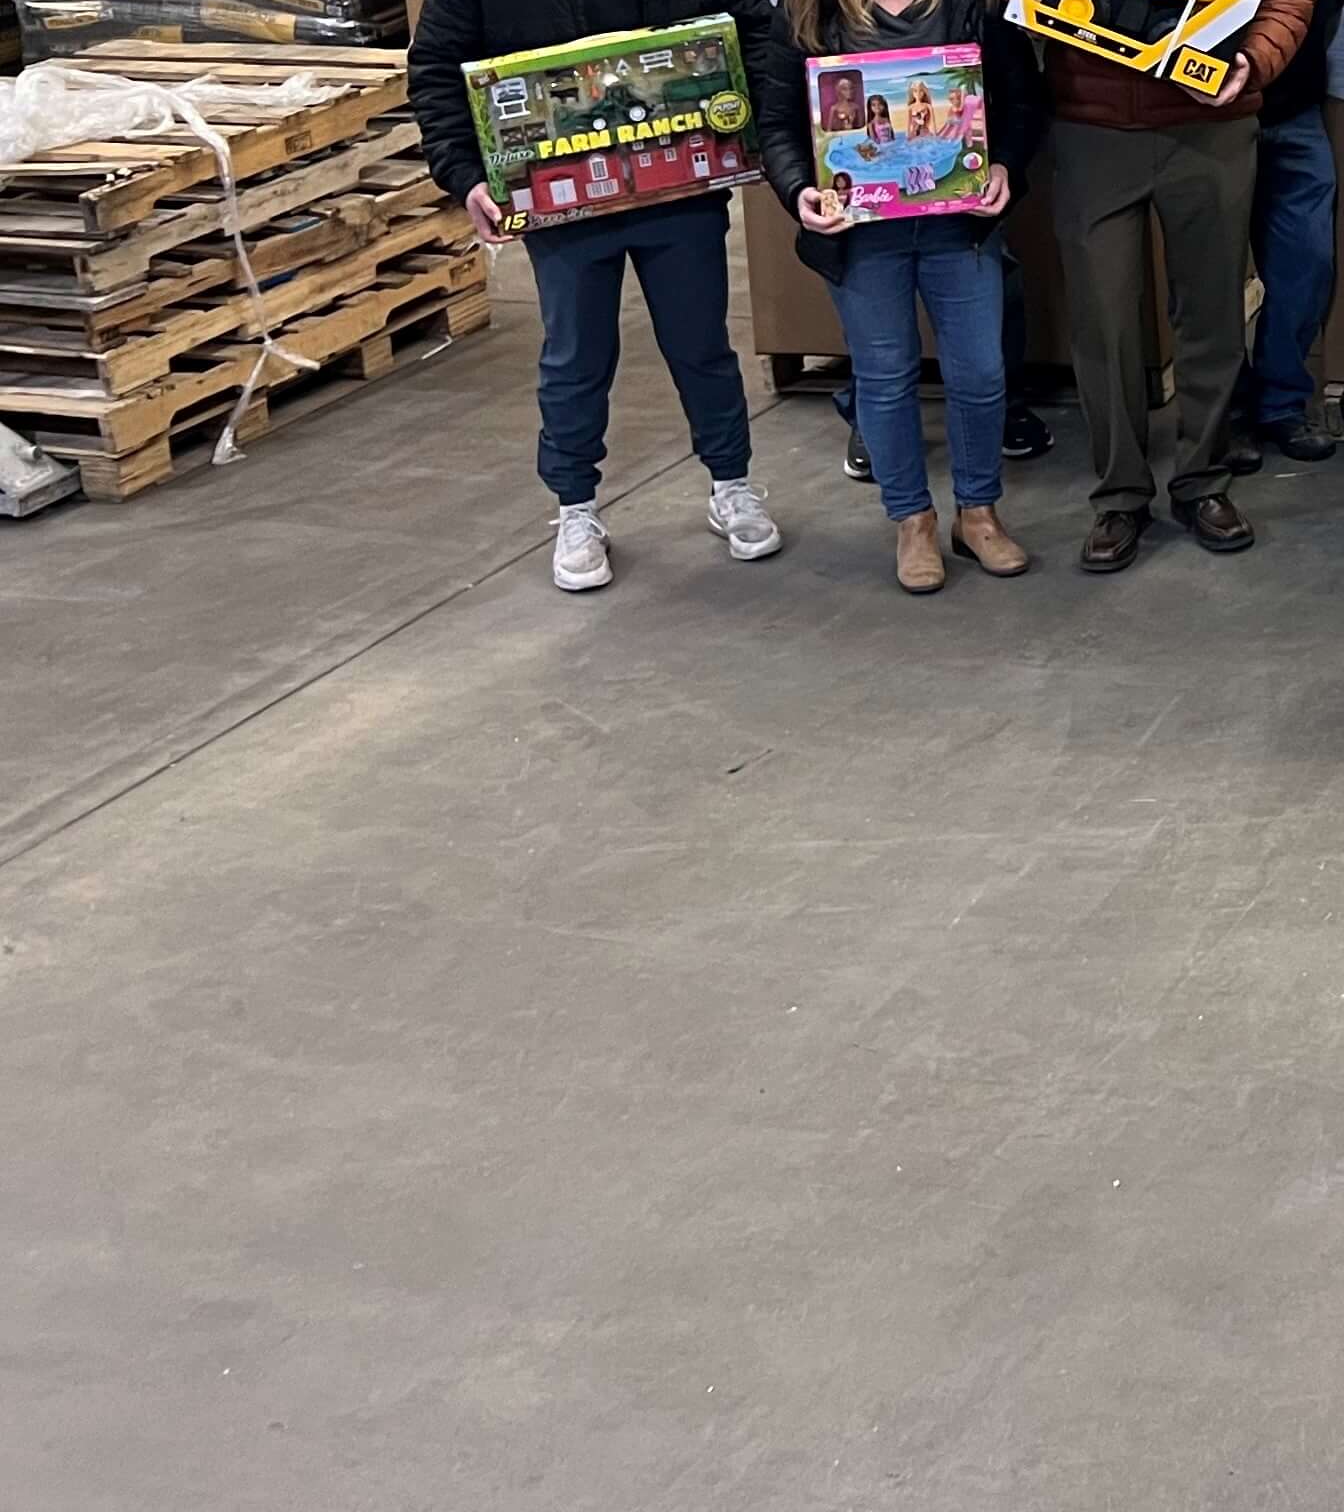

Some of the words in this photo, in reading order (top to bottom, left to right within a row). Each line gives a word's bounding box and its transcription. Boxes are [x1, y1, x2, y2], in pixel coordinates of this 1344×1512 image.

[1183, 58, 1218, 84] CAT
[537, 129, 612, 160] FARM
[617, 112, 704, 144] RANCH
[850, 186, 894, 207] Barbie
[504, 211, 527, 231] 15
